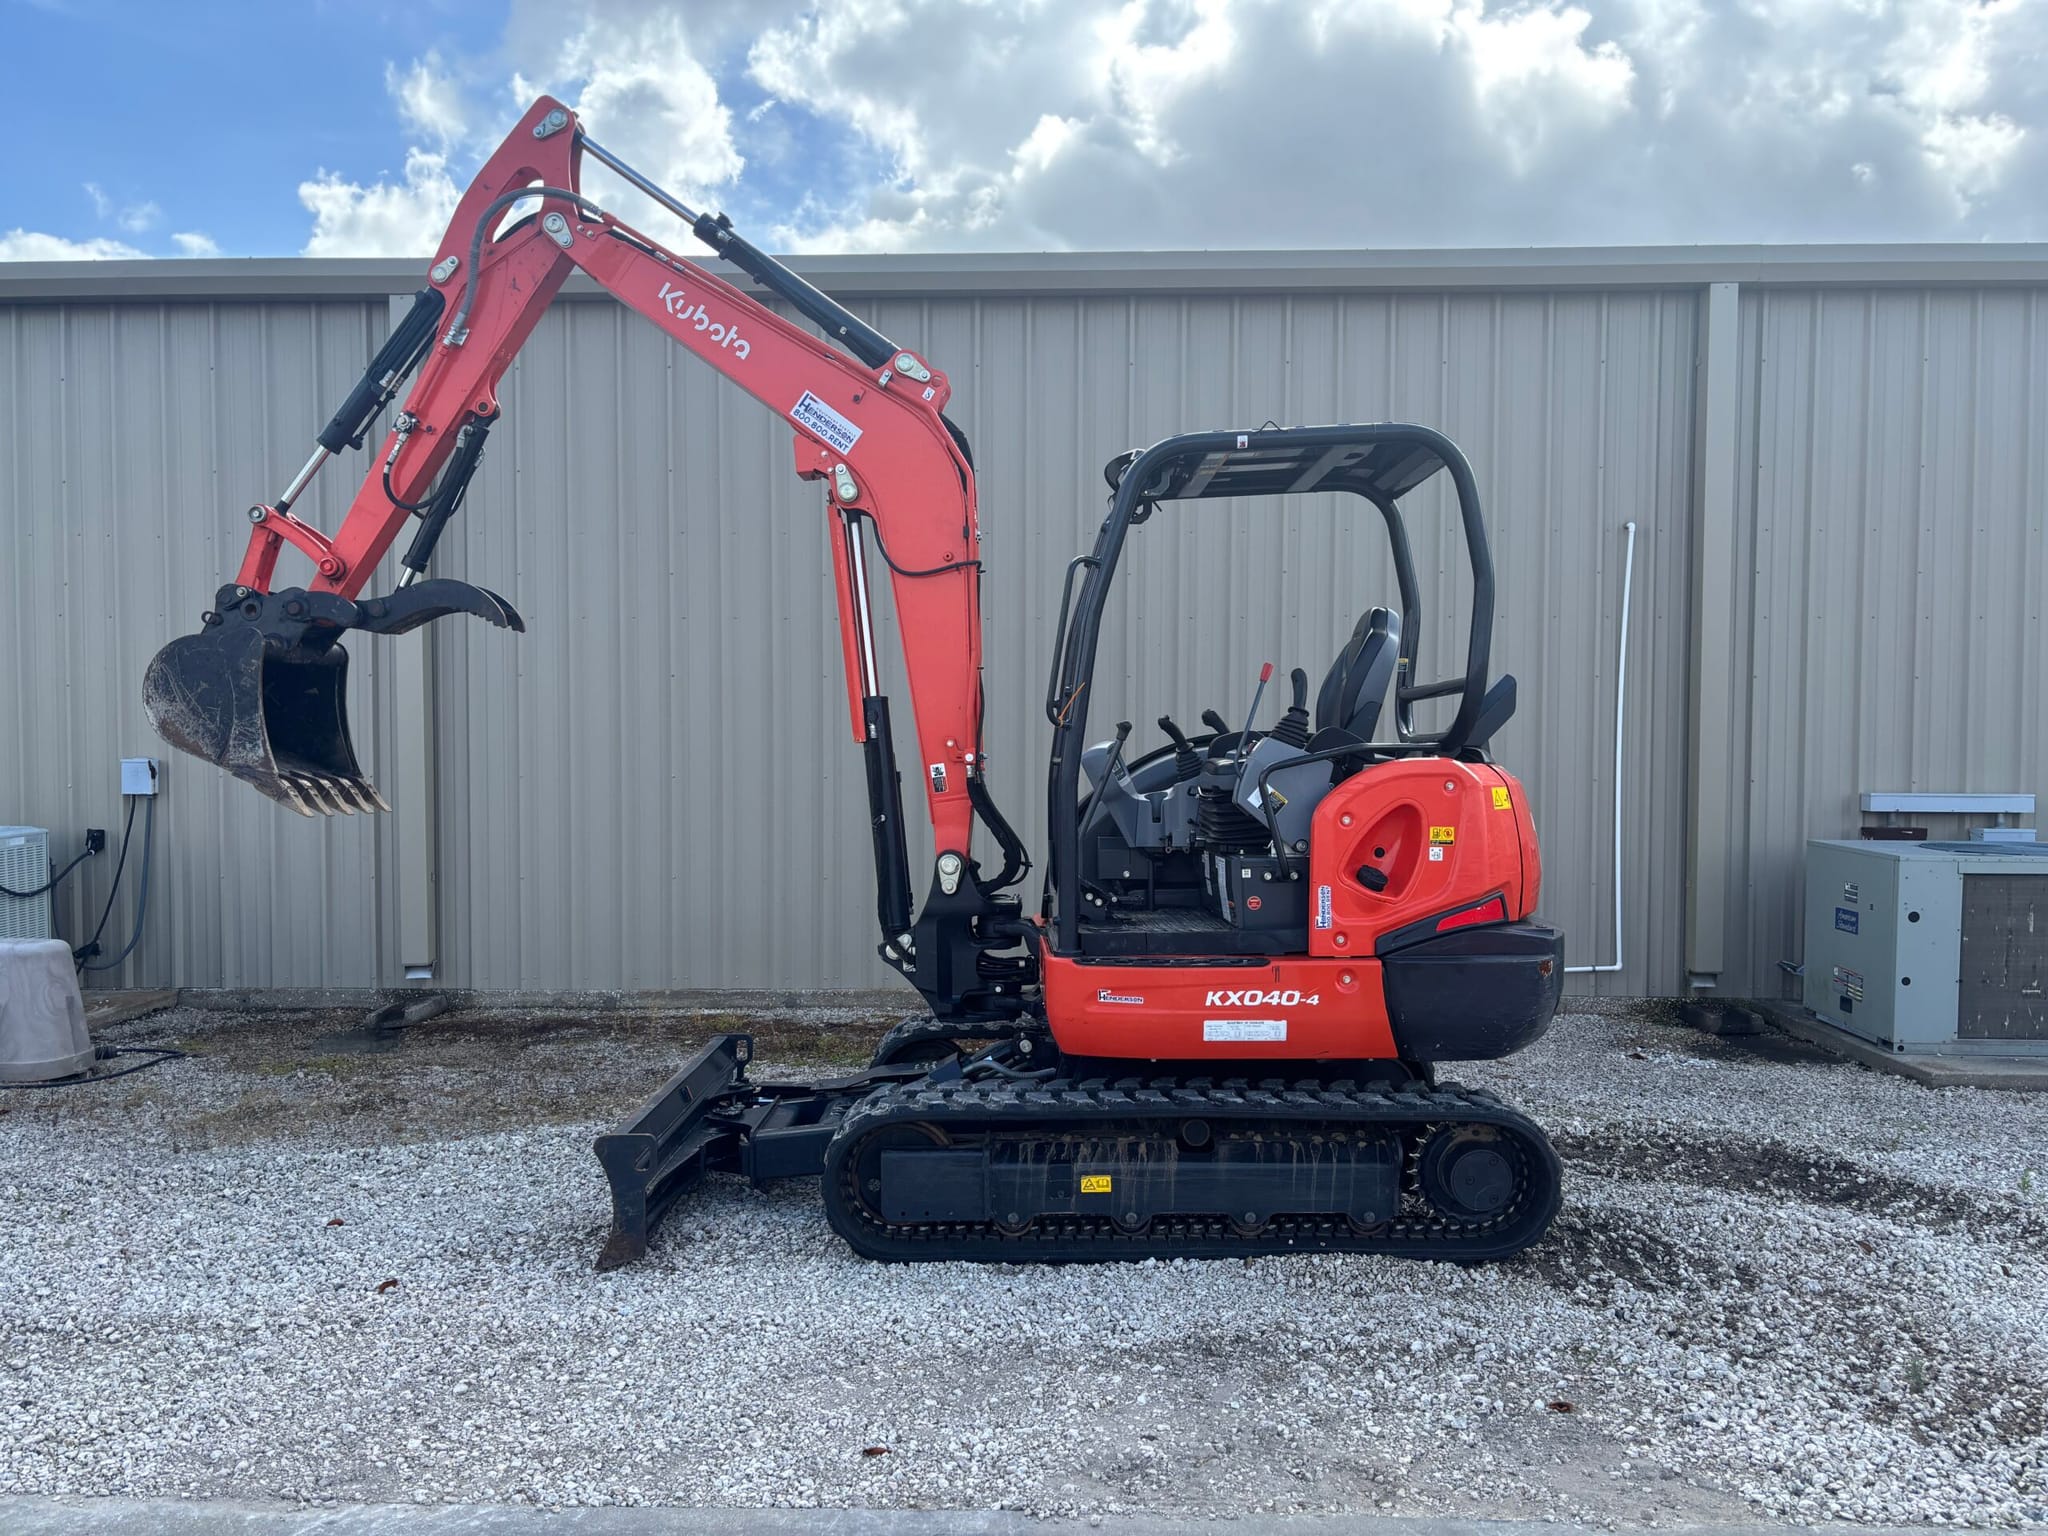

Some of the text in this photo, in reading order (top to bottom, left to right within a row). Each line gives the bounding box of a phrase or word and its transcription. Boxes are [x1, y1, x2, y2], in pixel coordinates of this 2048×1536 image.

[658, 282, 750, 360] Kubota
[793, 408, 850, 452] 800.800.RENT
[798, 392, 855, 444] HENDERSON
[1316, 886, 1327, 928] HENDERSON
[1099, 990, 1143, 1003] HENDERSON
[1205, 990, 1319, 1006] KX040-4
